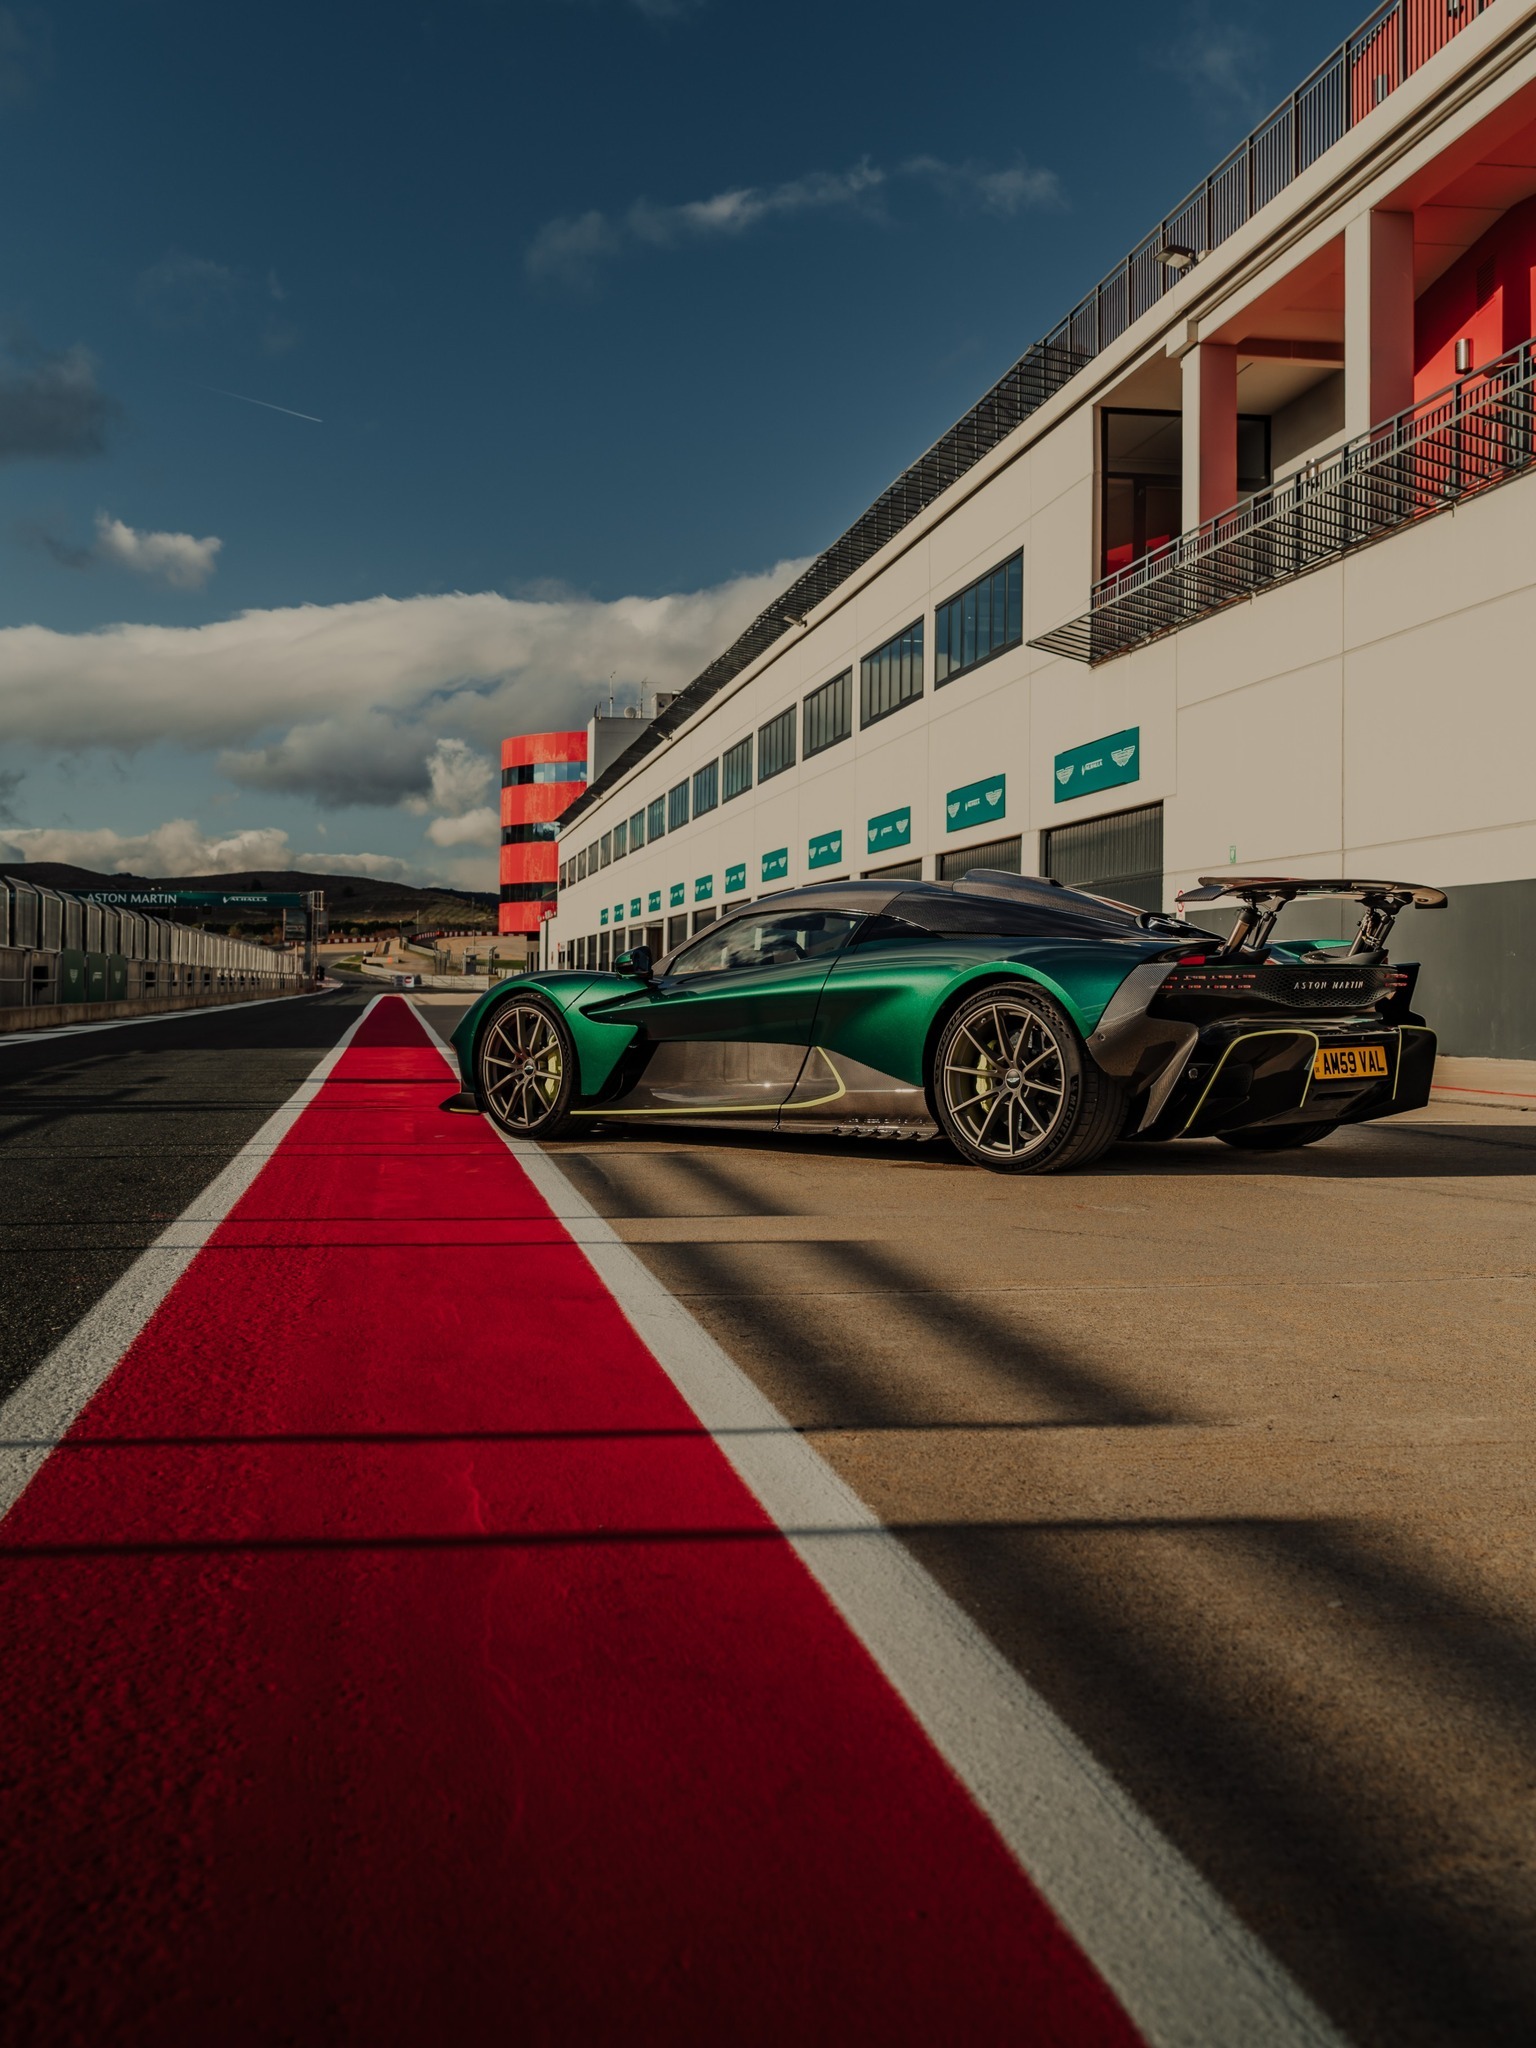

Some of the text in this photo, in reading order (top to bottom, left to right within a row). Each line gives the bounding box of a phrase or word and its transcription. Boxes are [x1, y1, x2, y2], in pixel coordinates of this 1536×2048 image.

[87, 893, 177, 904] ASTON MARTIN
[1294, 981, 1364, 990] ASTON MARTIN
[1323, 1050, 1385, 1075] AM59 VAL
[1048, 1094, 1077, 1151] MICHELIN
